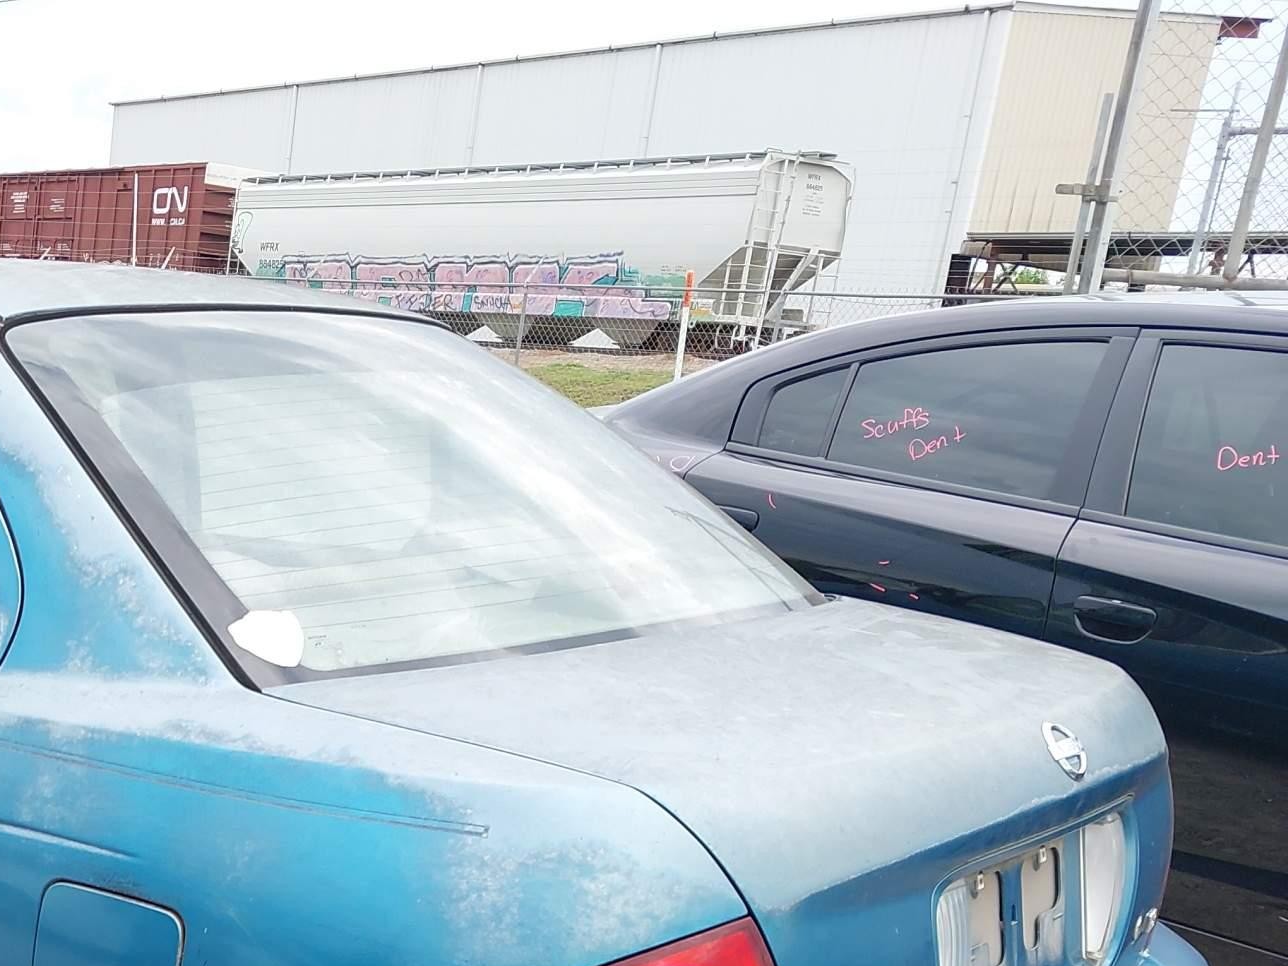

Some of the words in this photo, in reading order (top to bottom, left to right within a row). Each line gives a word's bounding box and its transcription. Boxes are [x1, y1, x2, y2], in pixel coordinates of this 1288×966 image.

[152, 185, 188, 214] CN
[861, 407, 930, 439] Scuffs
[909, 425, 967, 461] Dent
[1217, 444, 1280, 471] Dent
